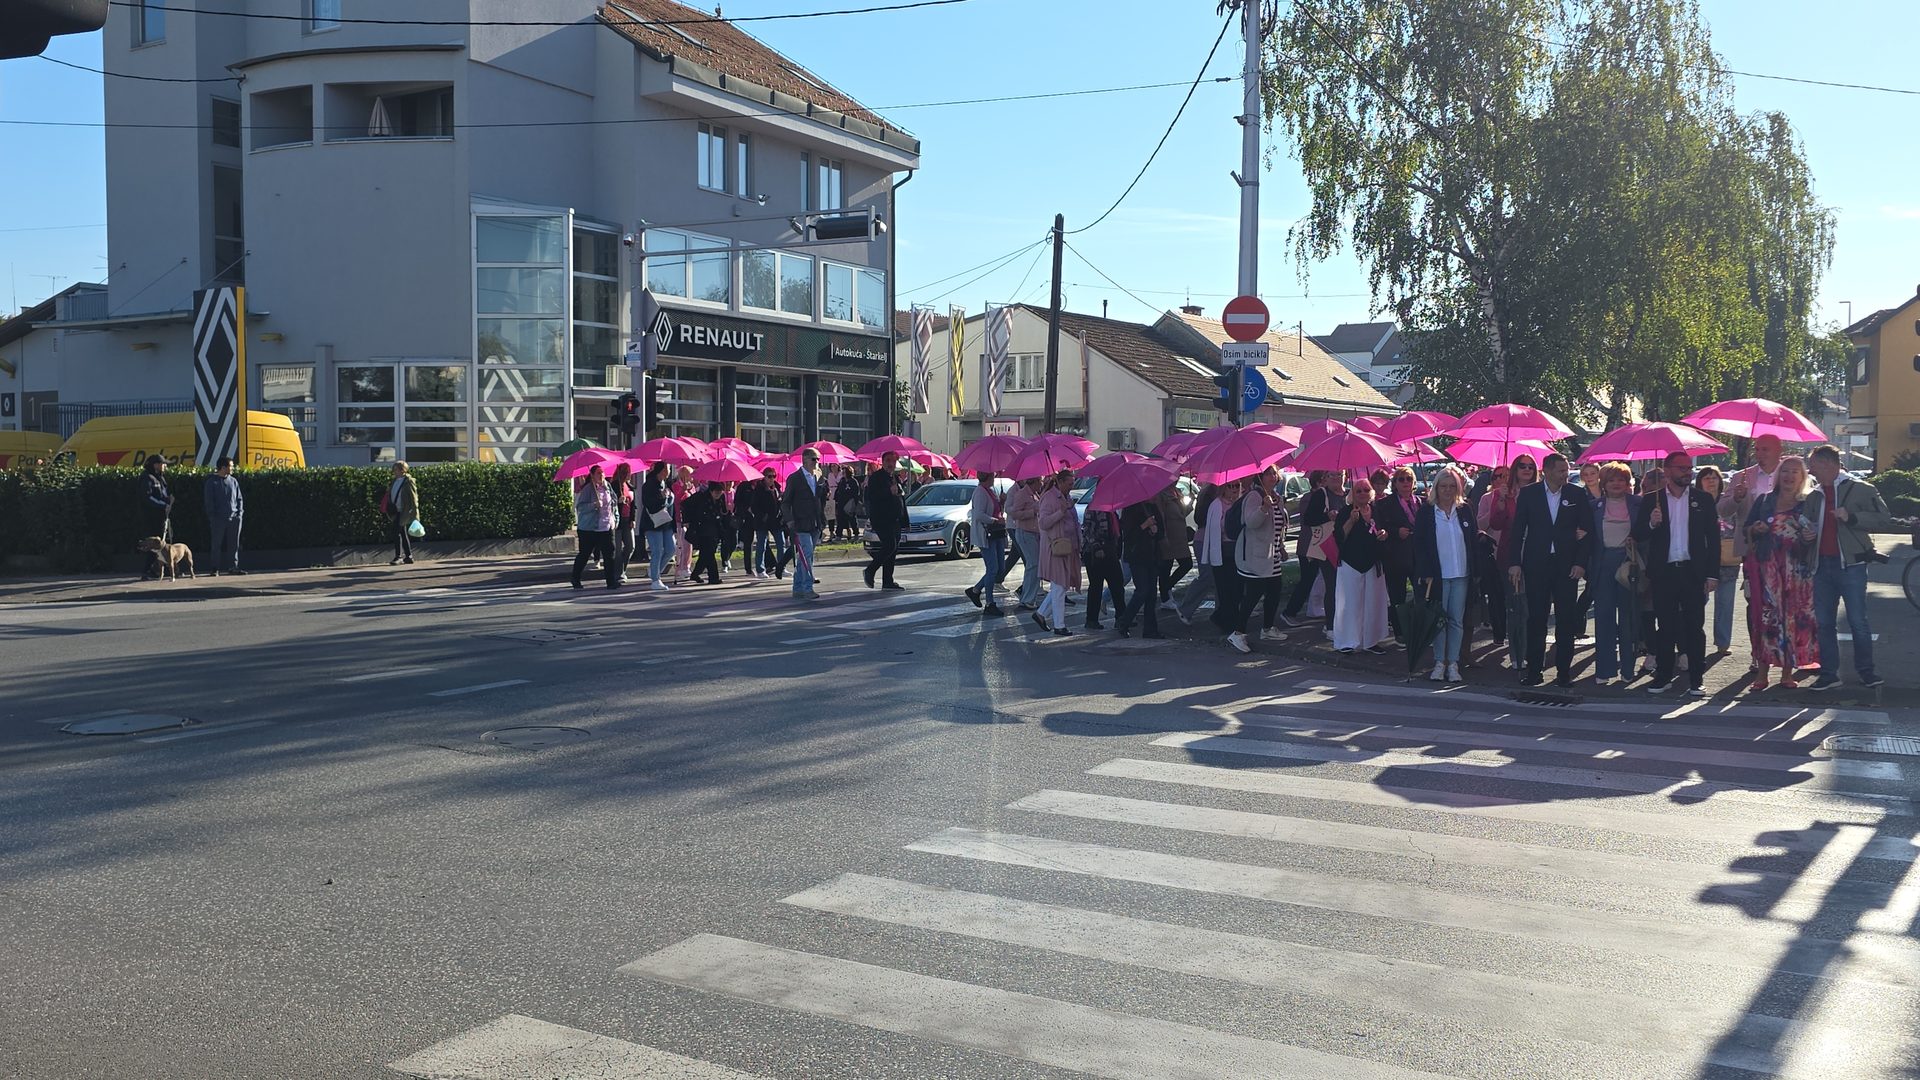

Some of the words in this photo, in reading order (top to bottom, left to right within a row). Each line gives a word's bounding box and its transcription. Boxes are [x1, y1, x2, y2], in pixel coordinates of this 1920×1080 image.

[679, 323, 764, 351] RENAULT
[1223, 349, 1241, 358] Osim
[1243, 349, 1267, 358] bicikla
[254, 452, 289, 468] Paket
